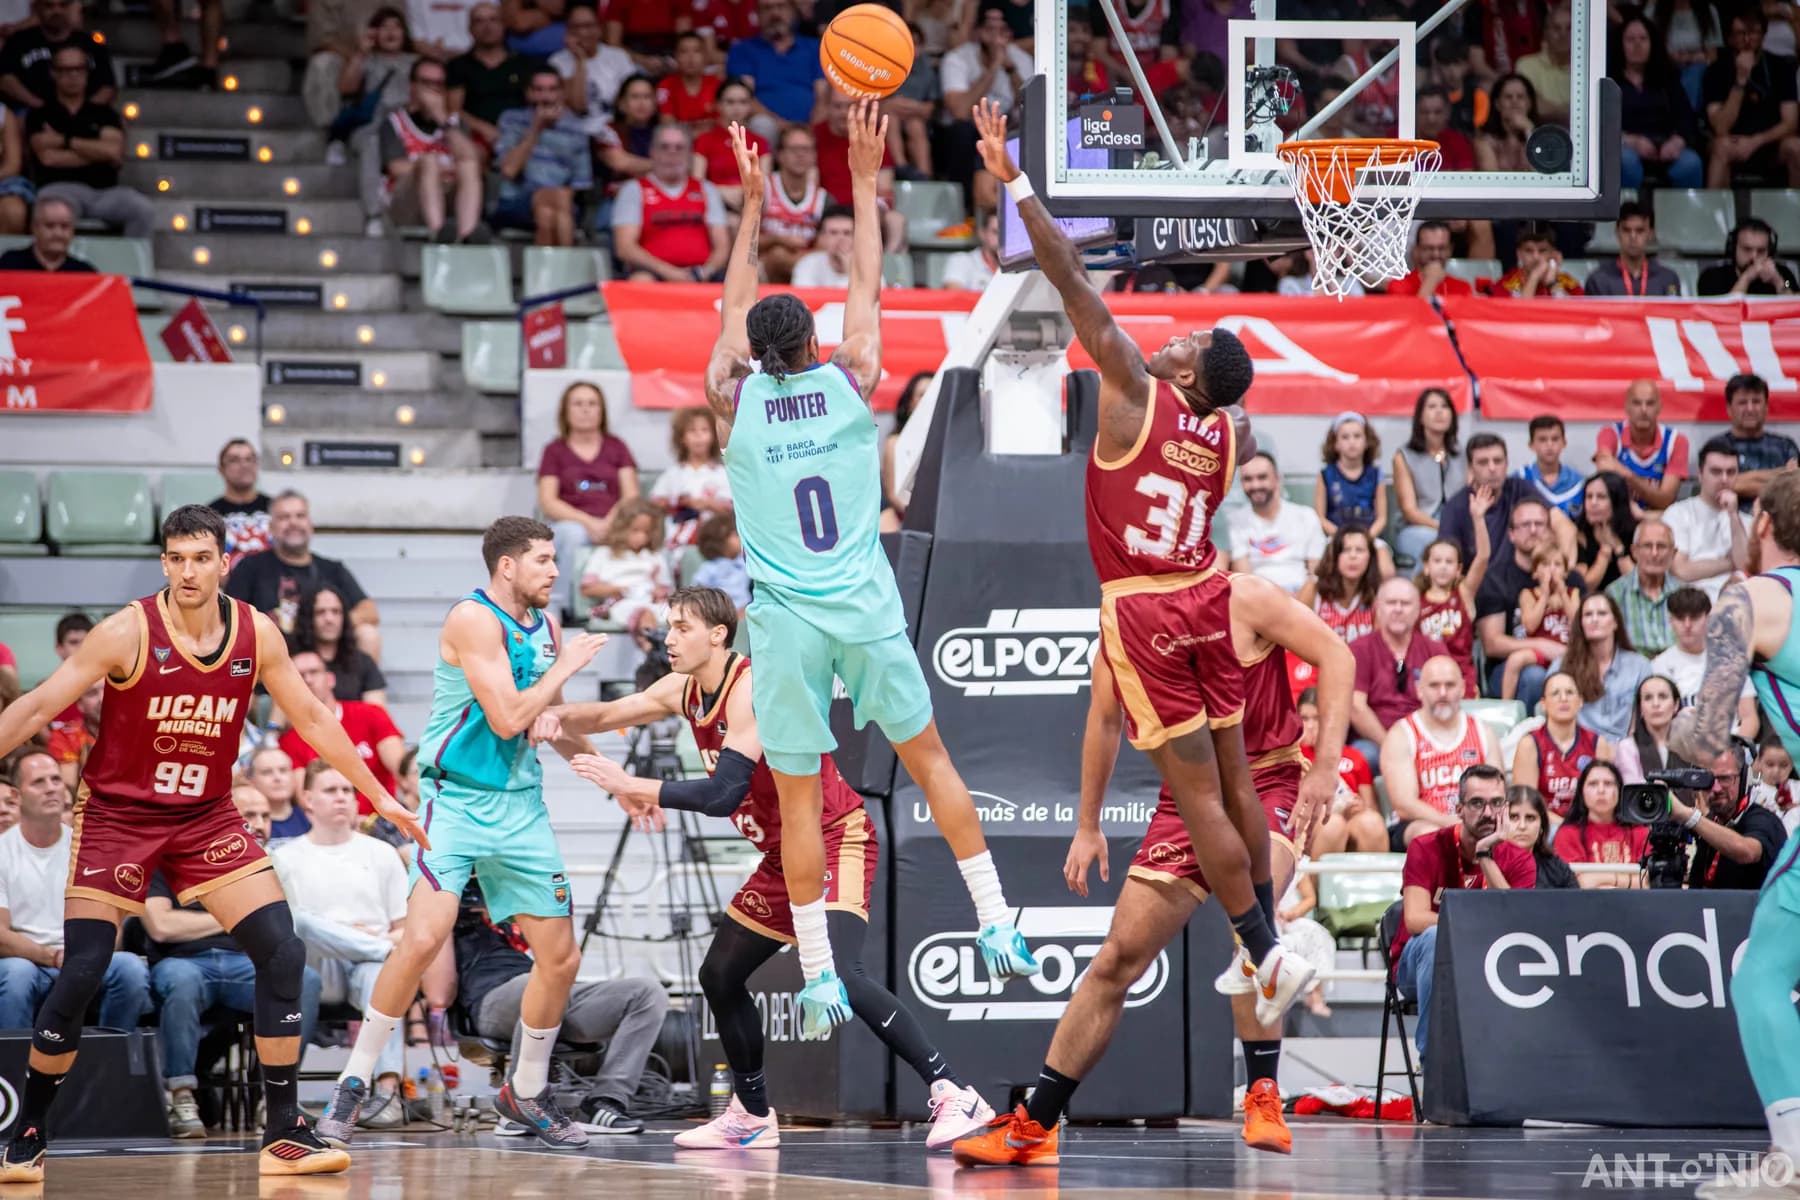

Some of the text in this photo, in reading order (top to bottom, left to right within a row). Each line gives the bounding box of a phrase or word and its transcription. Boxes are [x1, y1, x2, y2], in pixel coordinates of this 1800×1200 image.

[1083, 118, 1111, 134] liga
[1084, 132, 1142, 146] endesa
[765, 391, 828, 424] PUNTER
[786, 439, 815, 451] BARÇA
[788, 442, 838, 460] FOUNDATION
[794, 475, 839, 553] 0
[1124, 472, 1212, 556] 31
[146, 694, 239, 723] UCAM
[157, 719, 221, 738] MURCIA
[154, 761, 209, 797] 99
[1022, 803, 1048, 822] de
[1055, 803, 1073, 822] la
[736, 814, 765, 843] 13
[210, 839, 243, 861] Juver
[118, 870, 141, 886] Juver
